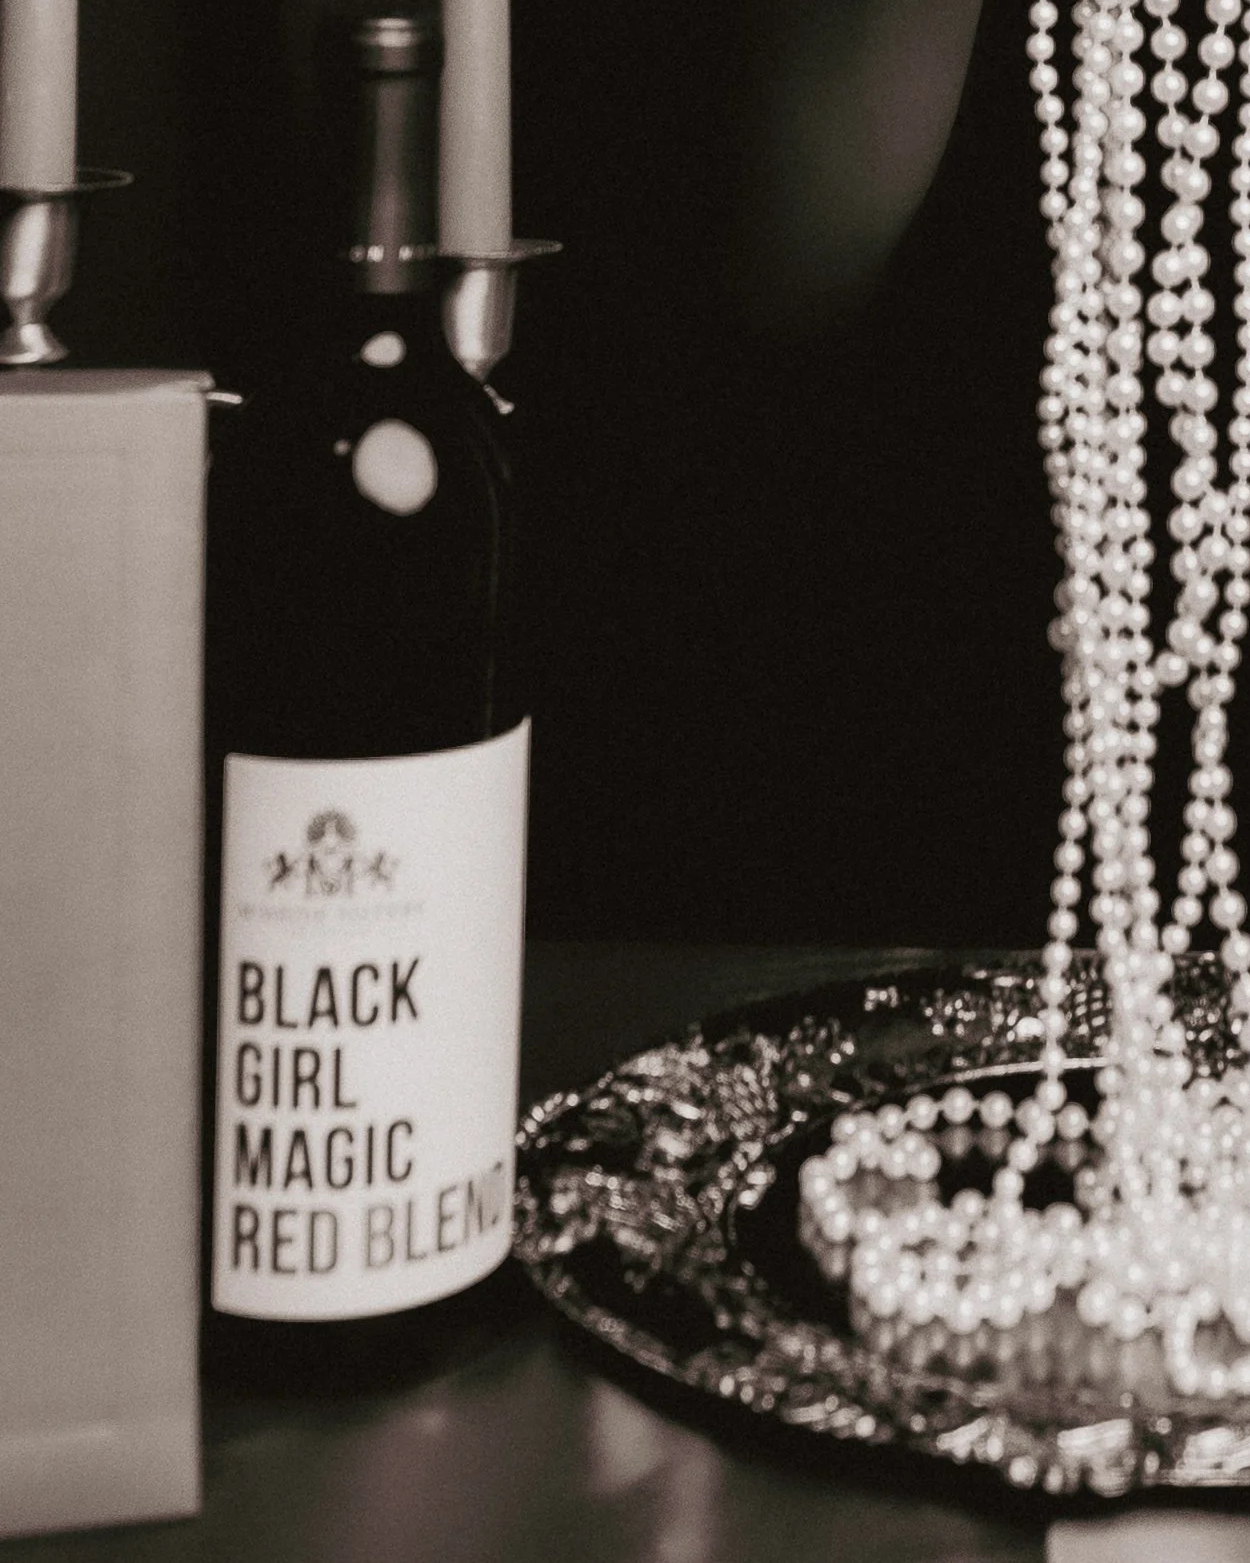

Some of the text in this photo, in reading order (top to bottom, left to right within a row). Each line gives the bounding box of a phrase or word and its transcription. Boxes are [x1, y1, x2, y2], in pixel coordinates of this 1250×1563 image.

[237, 957, 420, 1030] BLACK
[234, 1041, 358, 1111] GIRL
[232, 1119, 415, 1191] MAGIC
[231, 1204, 338, 1274] RED
